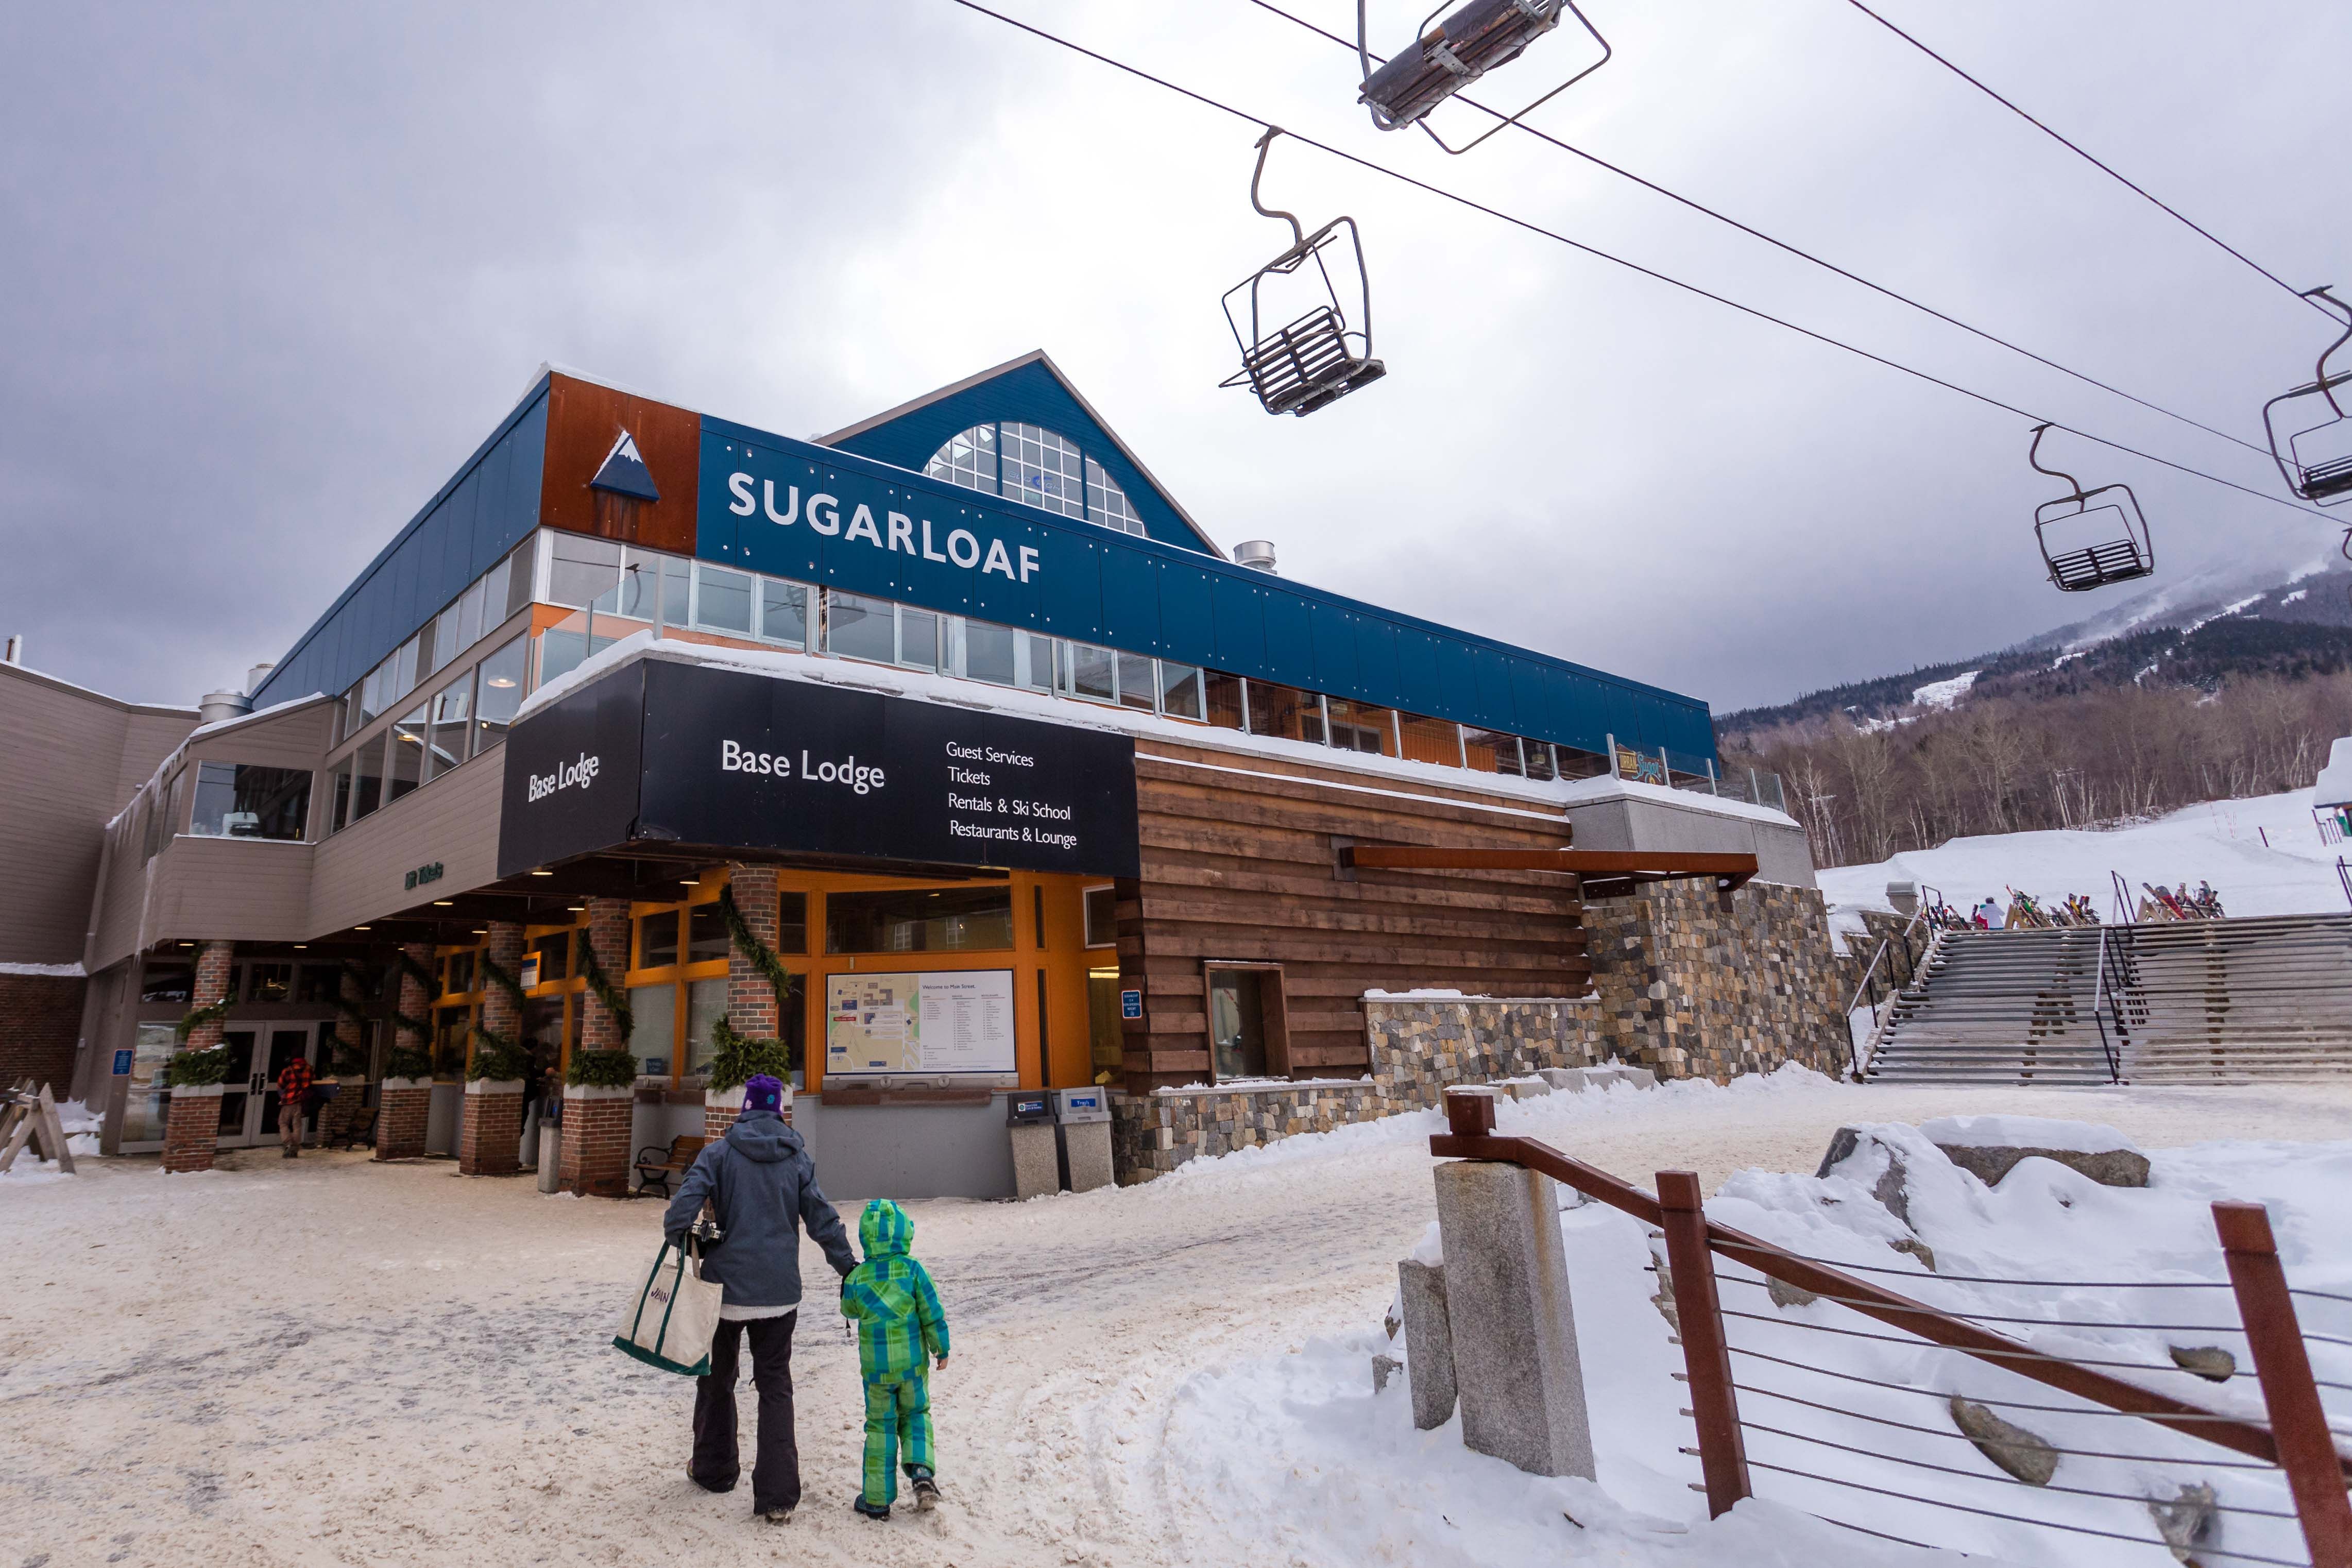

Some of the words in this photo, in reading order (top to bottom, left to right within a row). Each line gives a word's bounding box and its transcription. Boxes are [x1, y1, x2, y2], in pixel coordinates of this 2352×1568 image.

[728, 472, 1039, 583] SUGARLOAF
[723, 740, 790, 777] Base
[802, 750, 884, 794] Lodge
[946, 742, 982, 760] Guest
[986, 747, 1033, 766] Services
[1620, 755, 1637, 769] URBAN
[529, 775, 555, 802] Base
[558, 752, 599, 789] Lodge
[947, 766, 990, 785] Tickets
[949, 793, 992, 811] Rentals
[998, 798, 1008, 813] &
[1013, 800, 1029, 815] Ski
[1033, 802, 1070, 820] School
[950, 820, 1019, 840] Restaurants
[1022, 828, 1032, 842] &
[1035, 828, 1077, 849] Lounge
